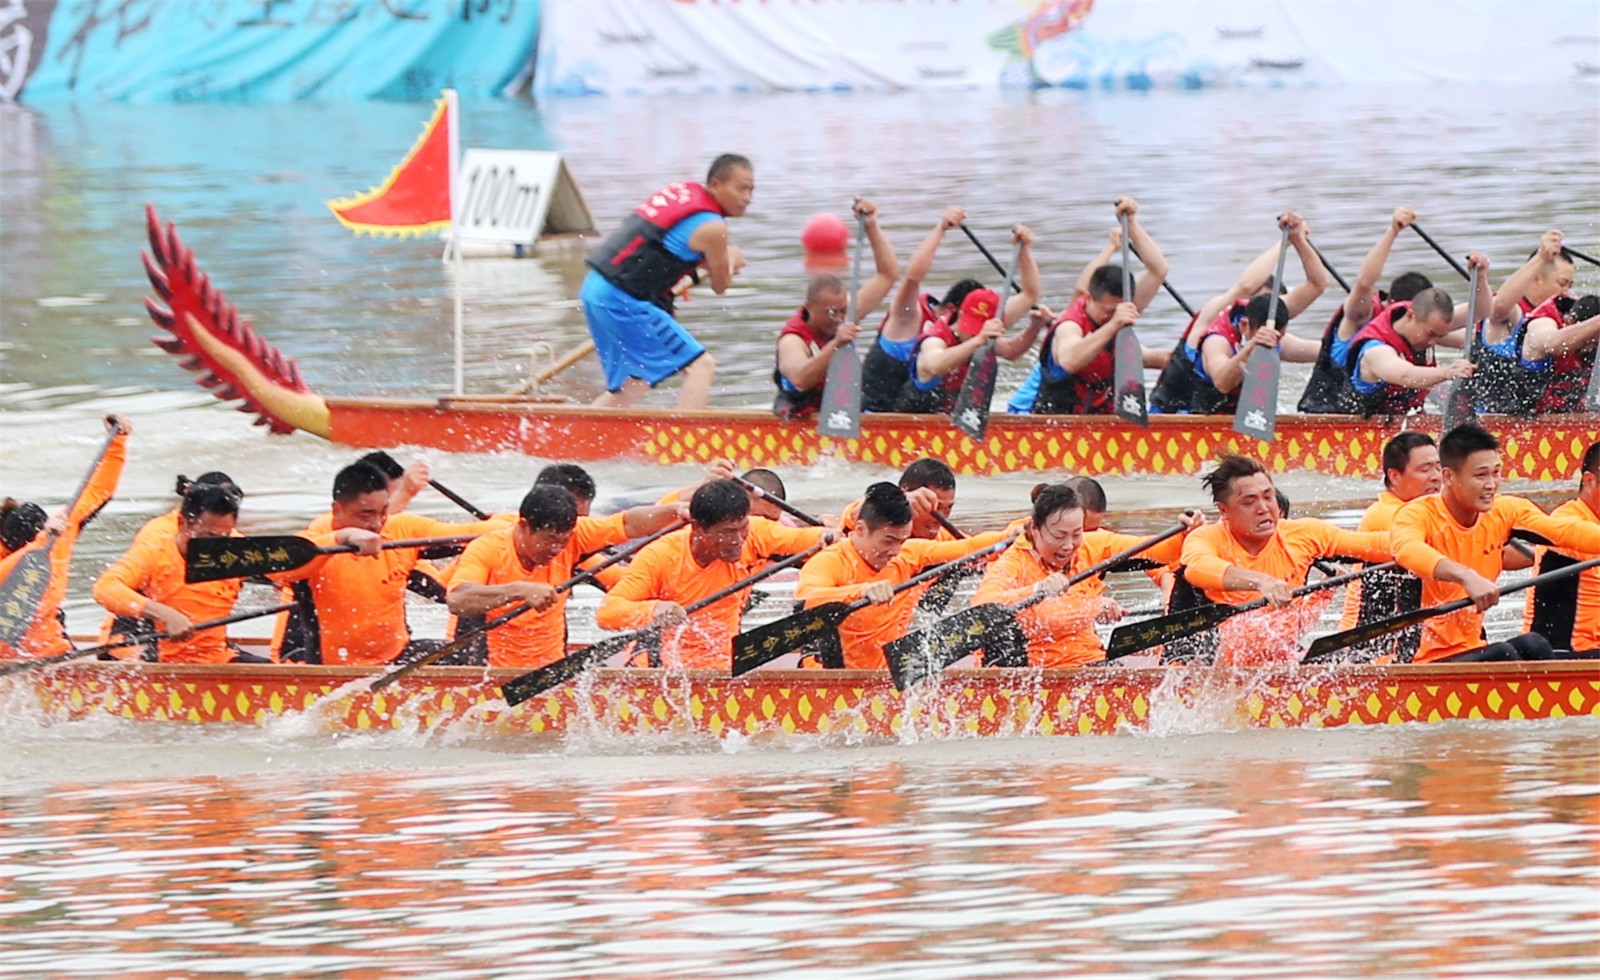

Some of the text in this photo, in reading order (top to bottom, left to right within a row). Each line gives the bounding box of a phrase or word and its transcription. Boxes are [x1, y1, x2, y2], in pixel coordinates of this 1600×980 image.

[459, 165, 540, 228] 100m
[194, 546, 290, 568] 重庆合川
[741, 617, 825, 660] 重庆合川
[1115, 617, 1207, 648] 重庆合川
